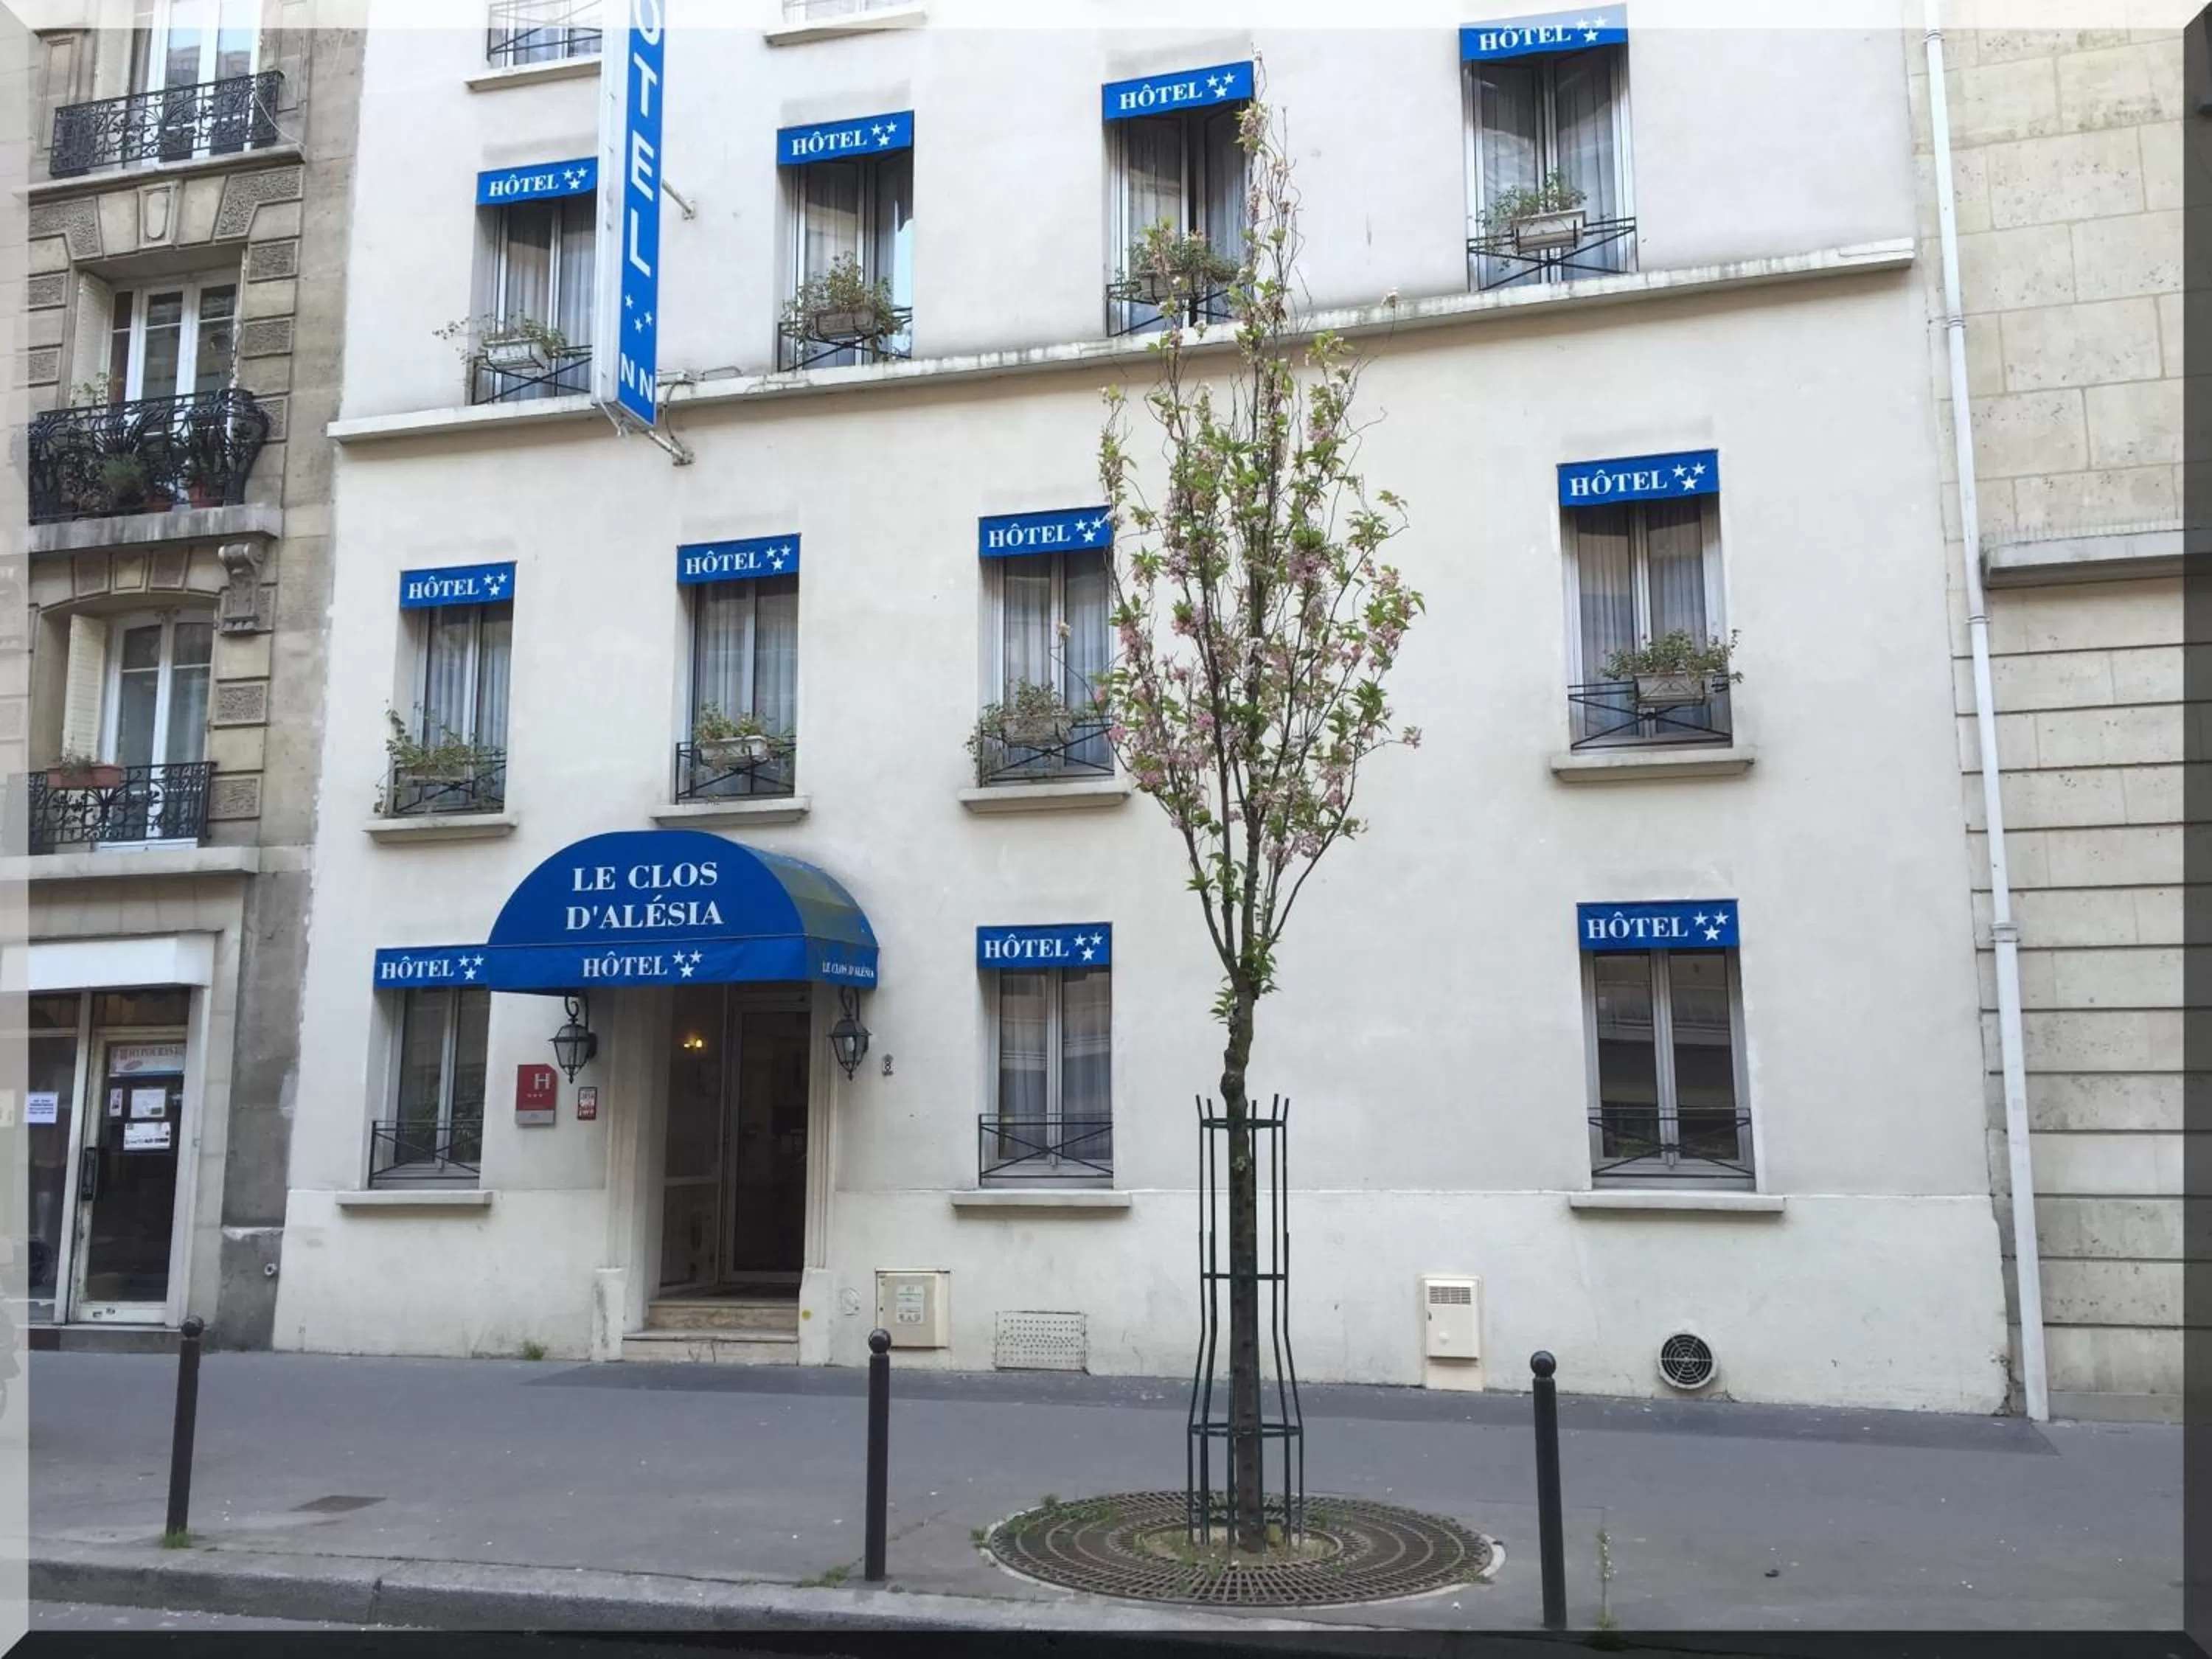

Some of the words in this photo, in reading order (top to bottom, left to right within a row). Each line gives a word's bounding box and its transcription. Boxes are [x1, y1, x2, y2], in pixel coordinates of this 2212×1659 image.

[1479, 26, 1571, 52] HÔTEL
[1120, 83, 1202, 110] HÔTEL
[792, 130, 868, 156] HÔTEL
[490, 174, 559, 197] HÔTEL
[1570, 470, 1668, 497] HÔTEL
[989, 524, 1071, 548] HÔTEL
[686, 550, 761, 575] HÔTEL
[408, 577, 479, 599] HÔTEL
[572, 866, 616, 891] LE
[628, 862, 717, 888] CLOS
[566, 894, 724, 931] D'ALÉSIA
[1587, 911, 1688, 939] HÔTEL
[984, 934, 1069, 959] HÔTEL
[380, 957, 454, 979] HÔTEL
[582, 952, 667, 978] HÔTEL
[822, 960, 831, 973] LE
[535, 1073, 550, 1090] H
